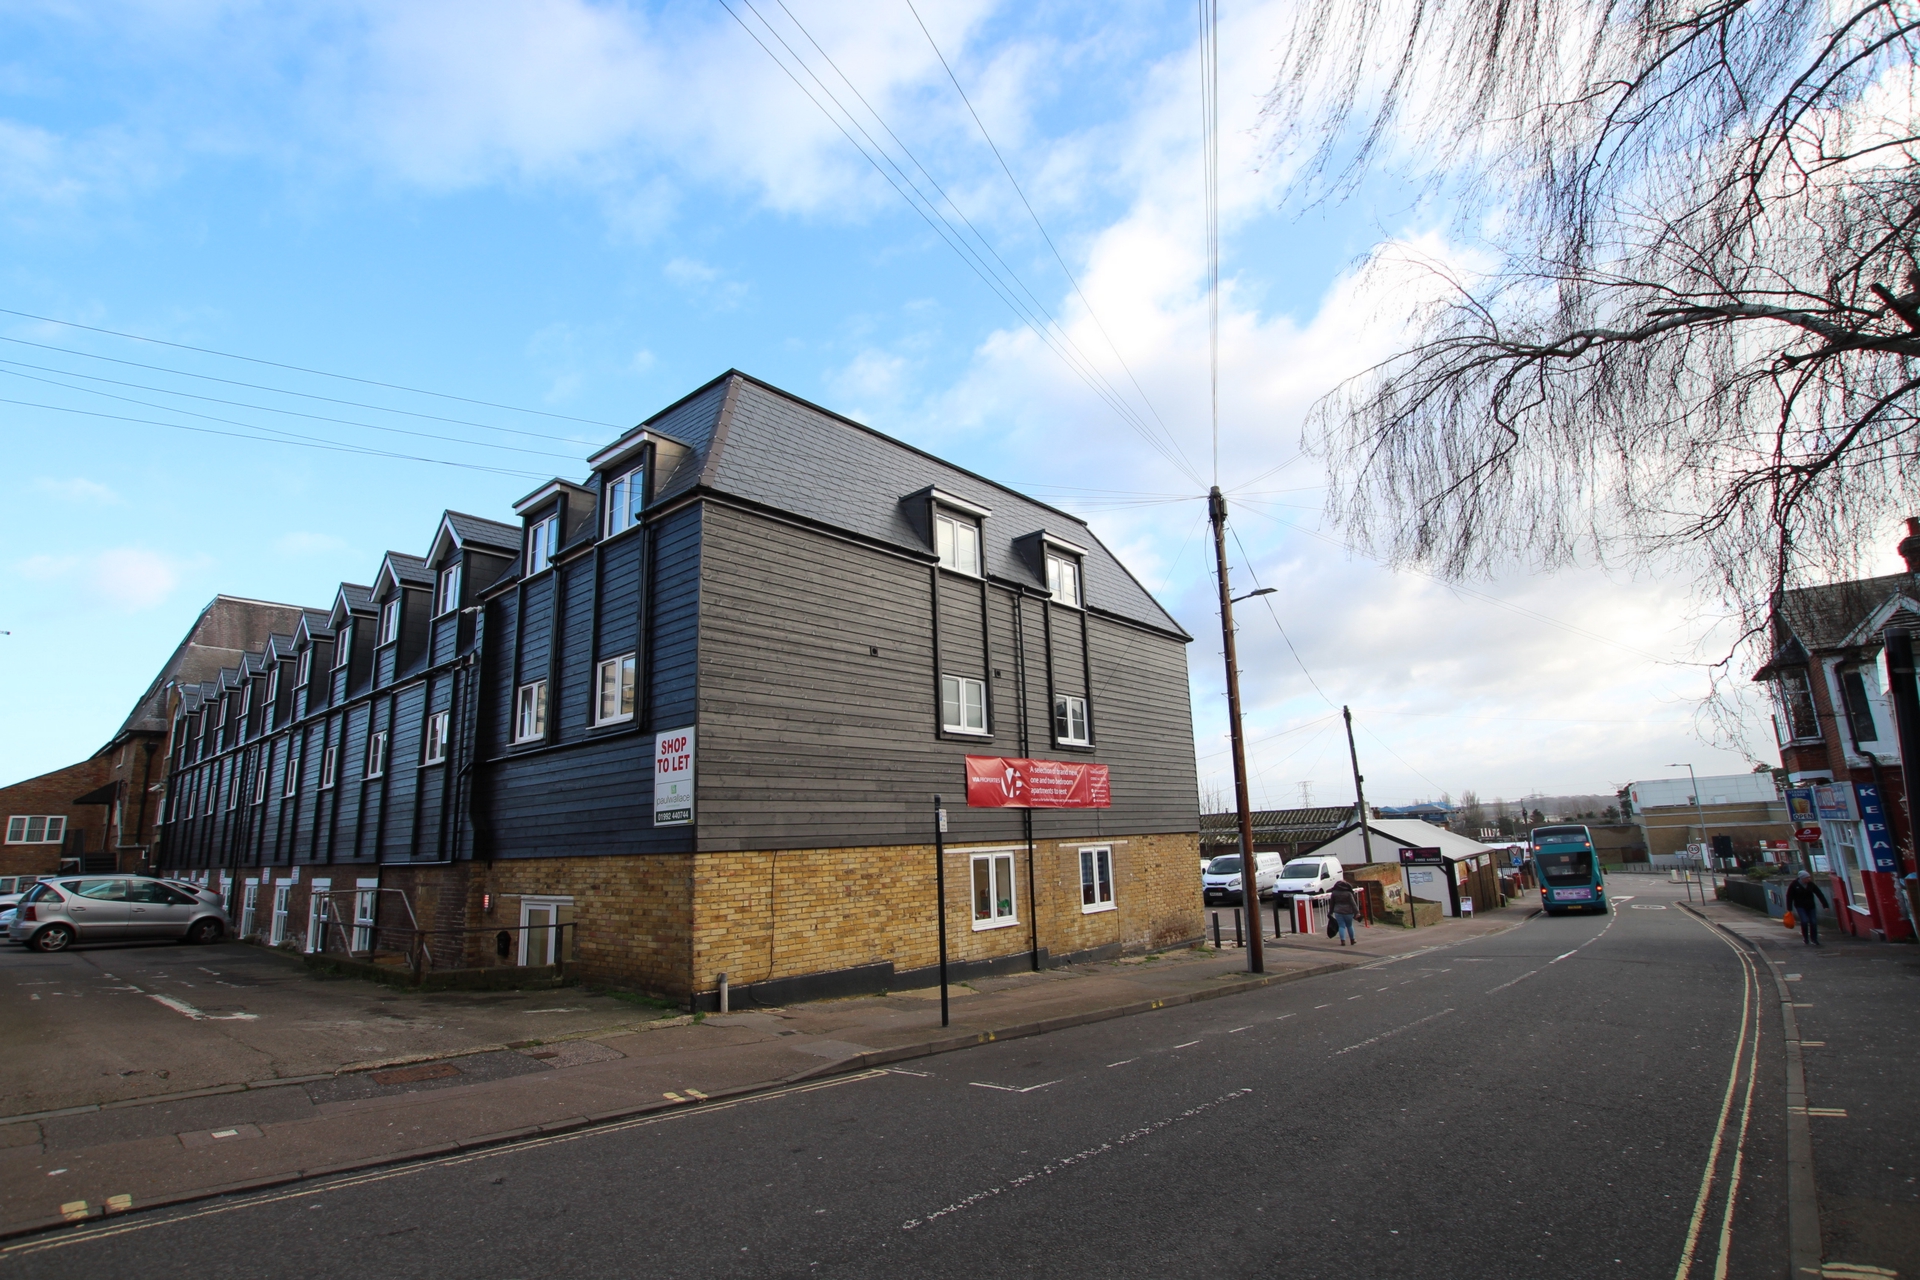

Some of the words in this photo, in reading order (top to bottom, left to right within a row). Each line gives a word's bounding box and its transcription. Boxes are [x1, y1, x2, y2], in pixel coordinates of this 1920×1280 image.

[661, 737, 687, 755] SHOP
[657, 758, 669, 773] TO
[672, 754, 690, 771] LET
[1055, 778, 1073, 786] bedroom
[1031, 788, 1053, 796] apartments
[1859, 788, 1895, 867] KEBAB
